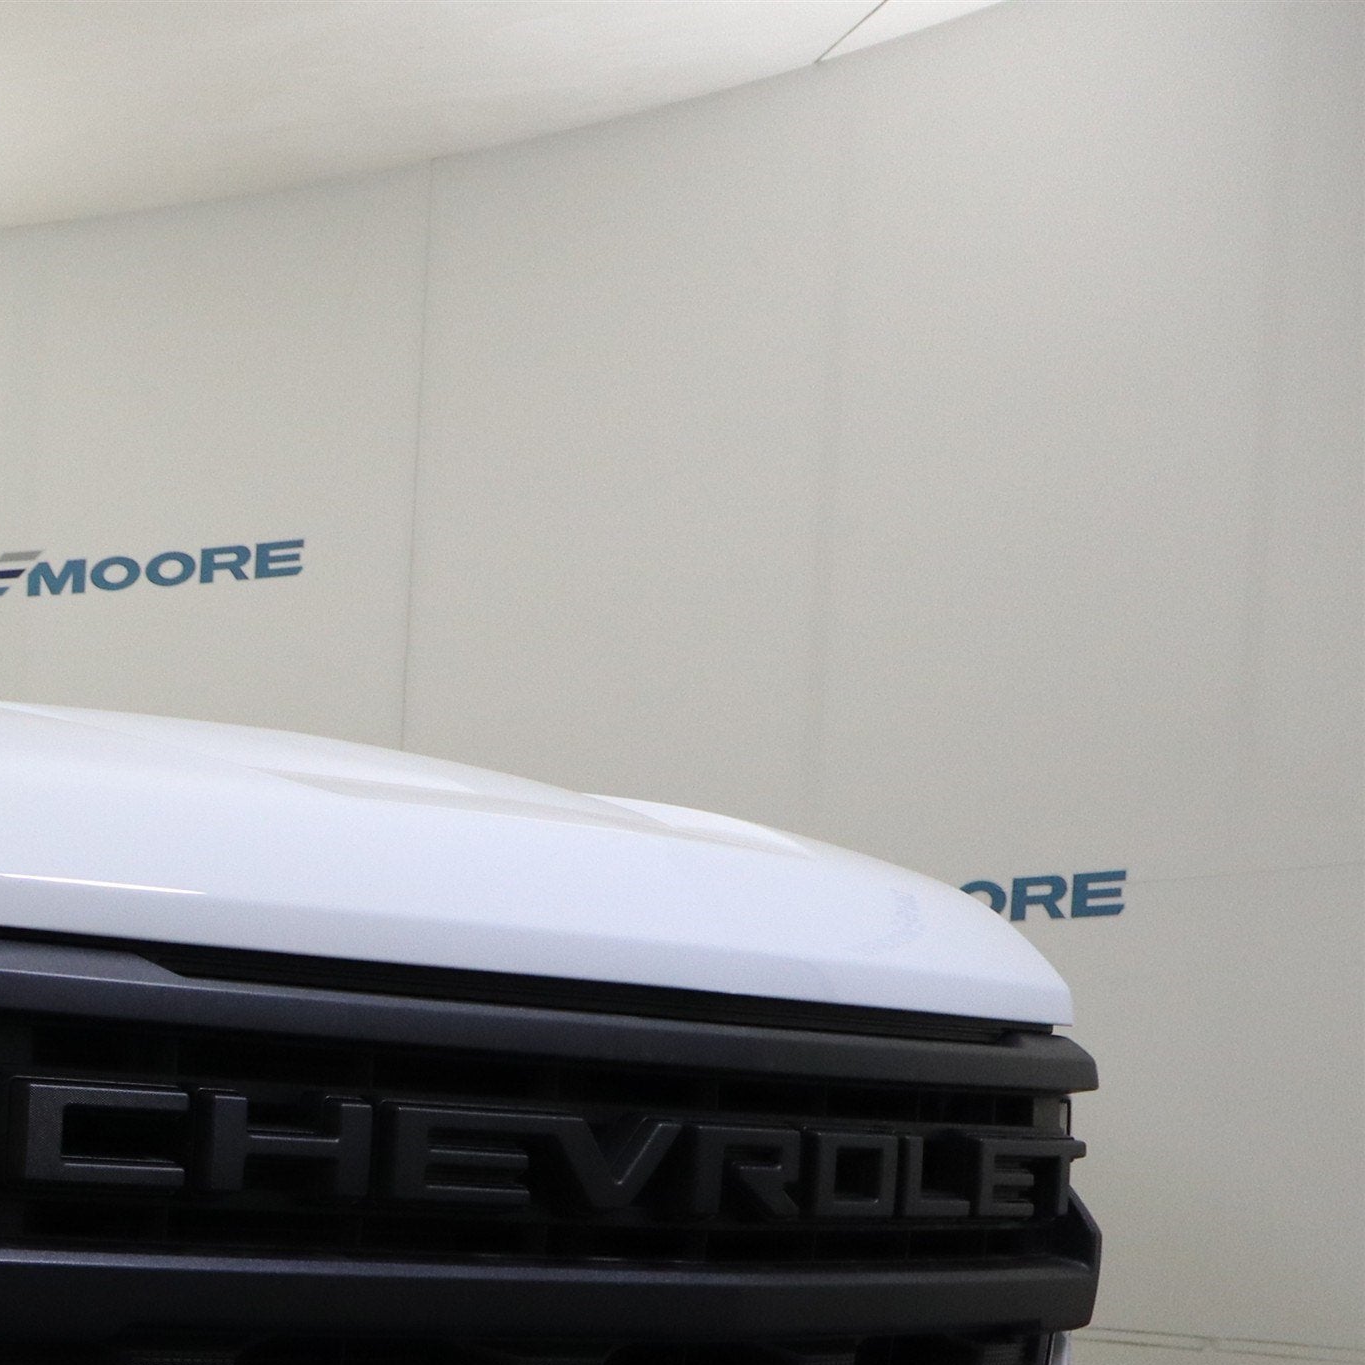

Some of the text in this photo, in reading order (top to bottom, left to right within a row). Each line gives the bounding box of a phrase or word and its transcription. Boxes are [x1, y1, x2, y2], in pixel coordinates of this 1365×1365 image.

[27, 539, 305, 597] MOORE
[959, 869, 1127, 922] ORE
[11, 1075, 1087, 1219] CHEVROLET
